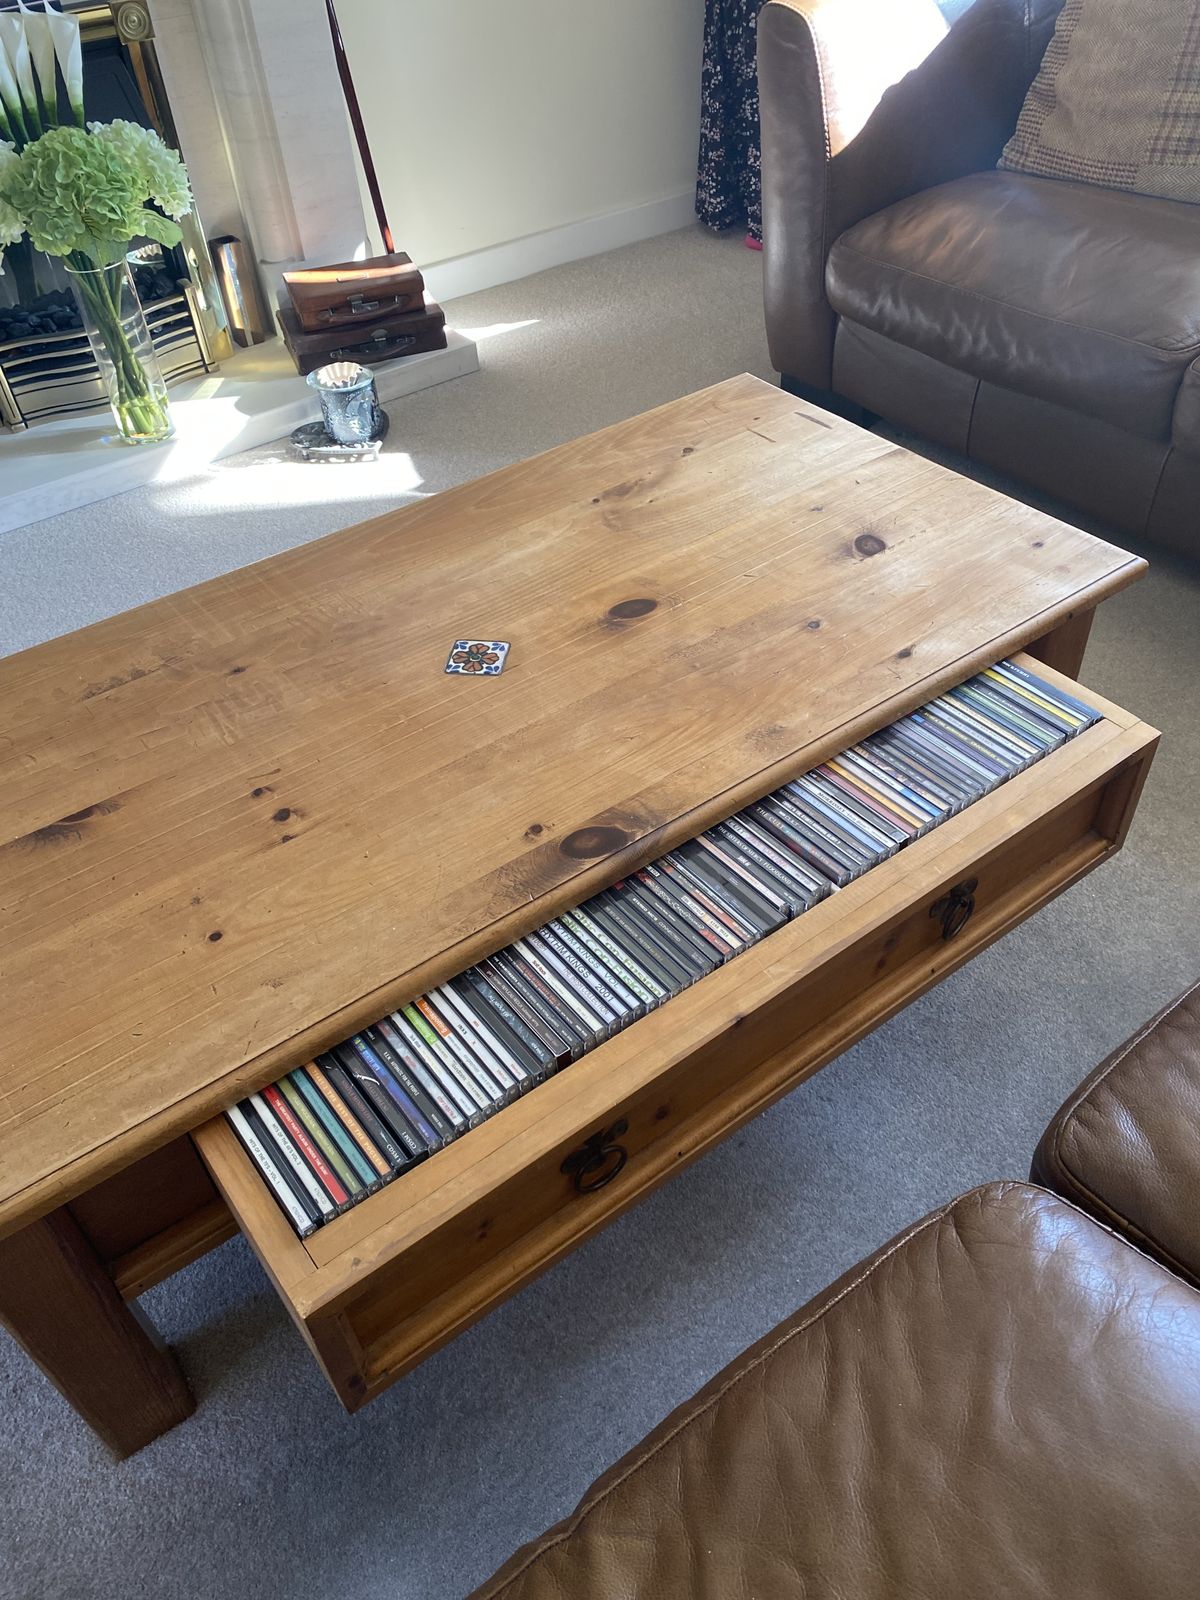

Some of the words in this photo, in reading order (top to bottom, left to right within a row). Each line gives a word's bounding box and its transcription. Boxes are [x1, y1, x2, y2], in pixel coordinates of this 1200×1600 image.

[762, 860, 792, 885] FLOODLAND
[548, 918, 577, 946] HYTHM
[575, 944, 600, 969] KINGS
[602, 972, 620, 989] VOL
[564, 952, 591, 979] KINGS
[594, 982, 615, 1002] 2001
[274, 1098, 282, 1107] THE
[279, 1105, 293, 1123] GREATEST
[290, 1121, 300, 1135] PARTY
[297, 1133, 309, 1147] ALBUM
[306, 1145, 317, 1159] UNDER
[314, 1157, 322, 1166] THE
